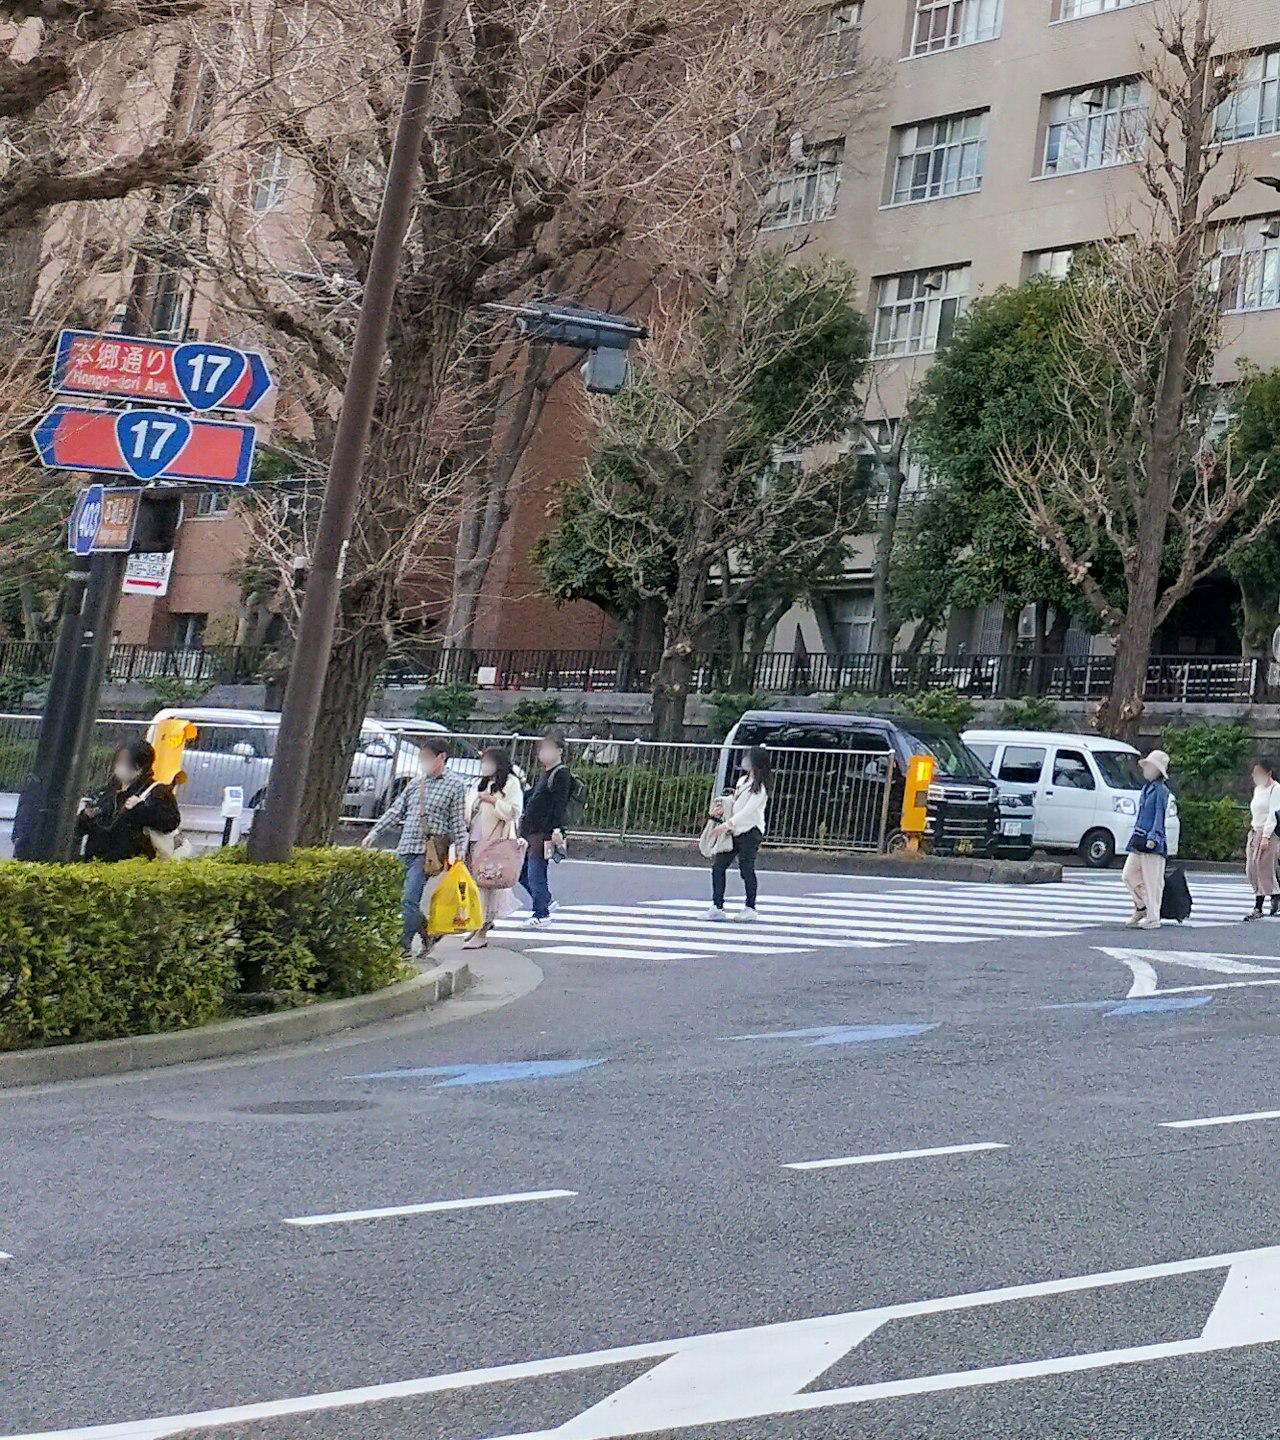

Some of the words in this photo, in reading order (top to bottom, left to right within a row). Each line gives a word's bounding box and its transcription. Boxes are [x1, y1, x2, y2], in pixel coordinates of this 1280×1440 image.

[144, 379, 169, 395] Ave.
[187, 353, 232, 393] 17
[130, 419, 177, 460] 17
